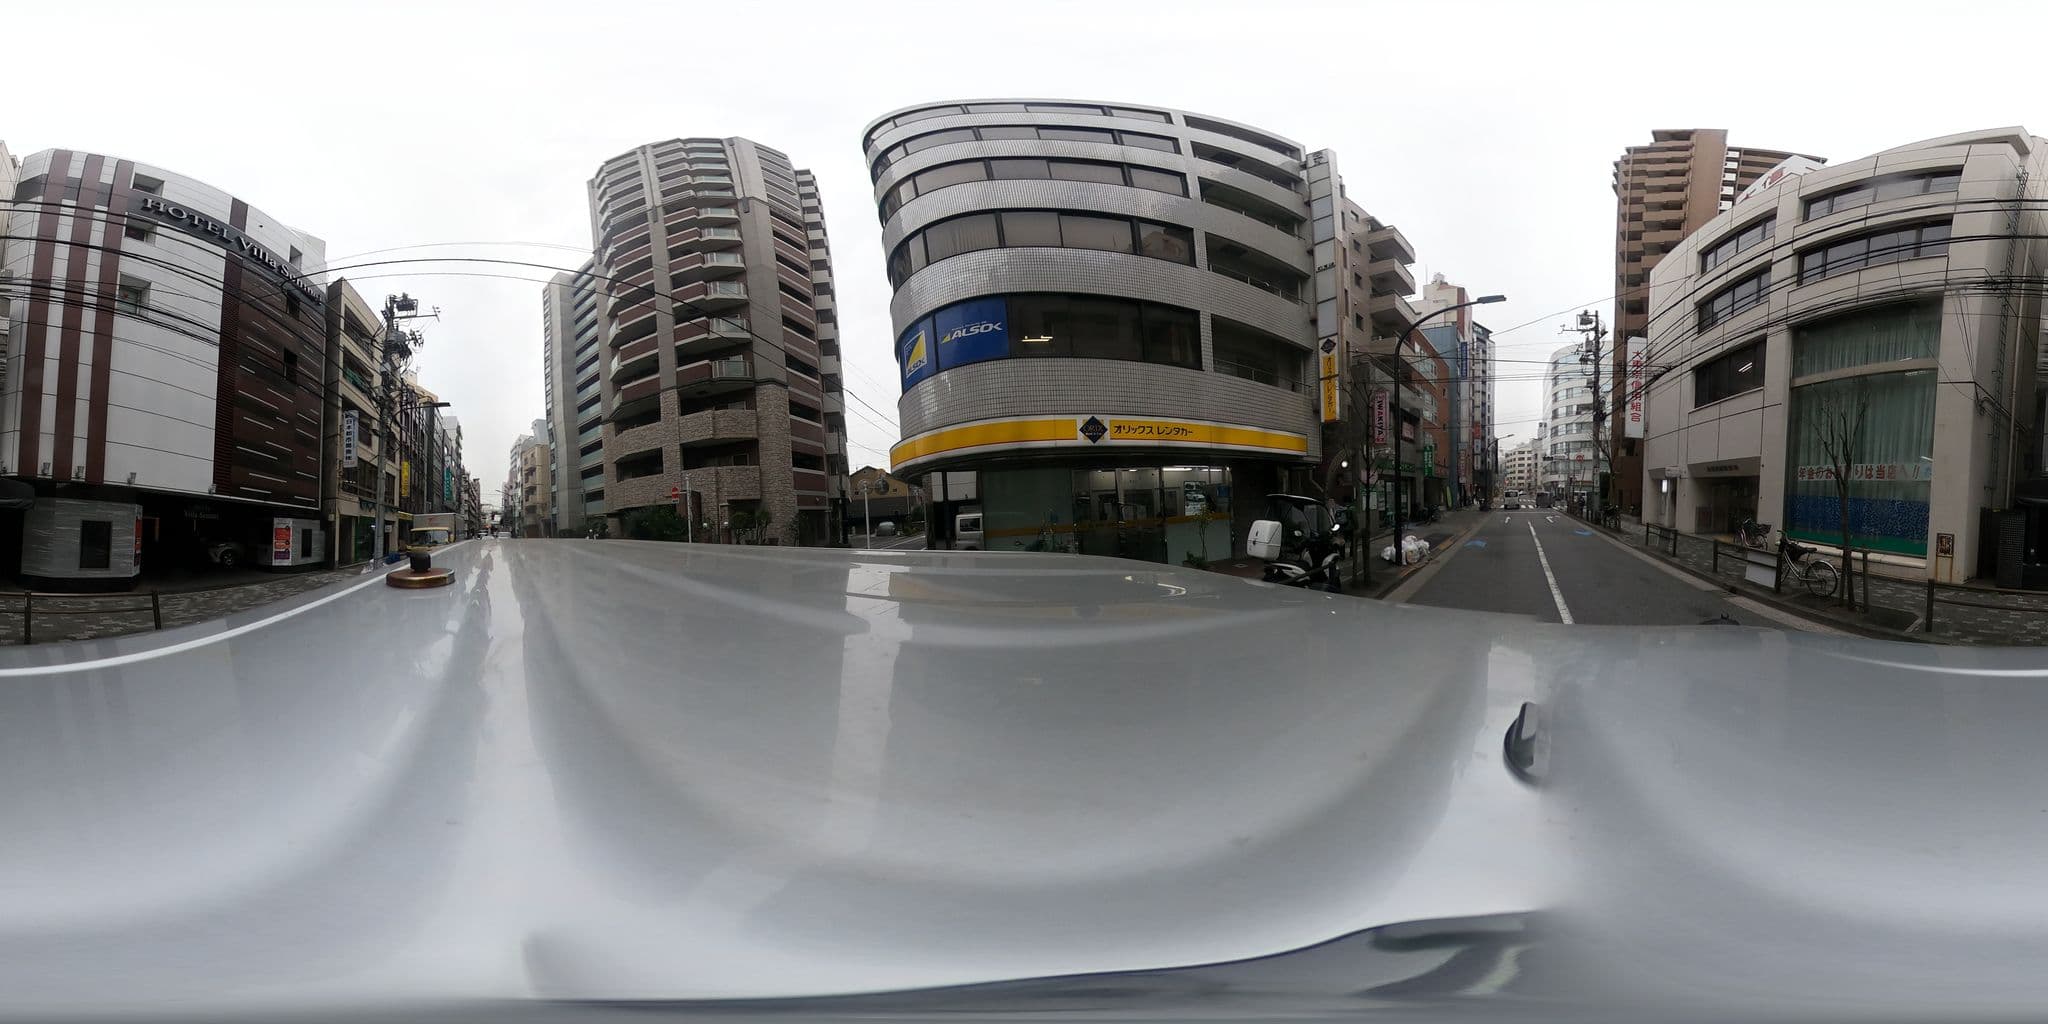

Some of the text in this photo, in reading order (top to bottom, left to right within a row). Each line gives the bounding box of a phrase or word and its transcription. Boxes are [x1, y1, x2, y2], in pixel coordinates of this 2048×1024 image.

[142, 197, 235, 243] HOTEL
[239, 236, 277, 270] Villa
[951, 322, 1003, 340] ALSOK
[1114, 425, 1193, 436] オリックス レンタカー
